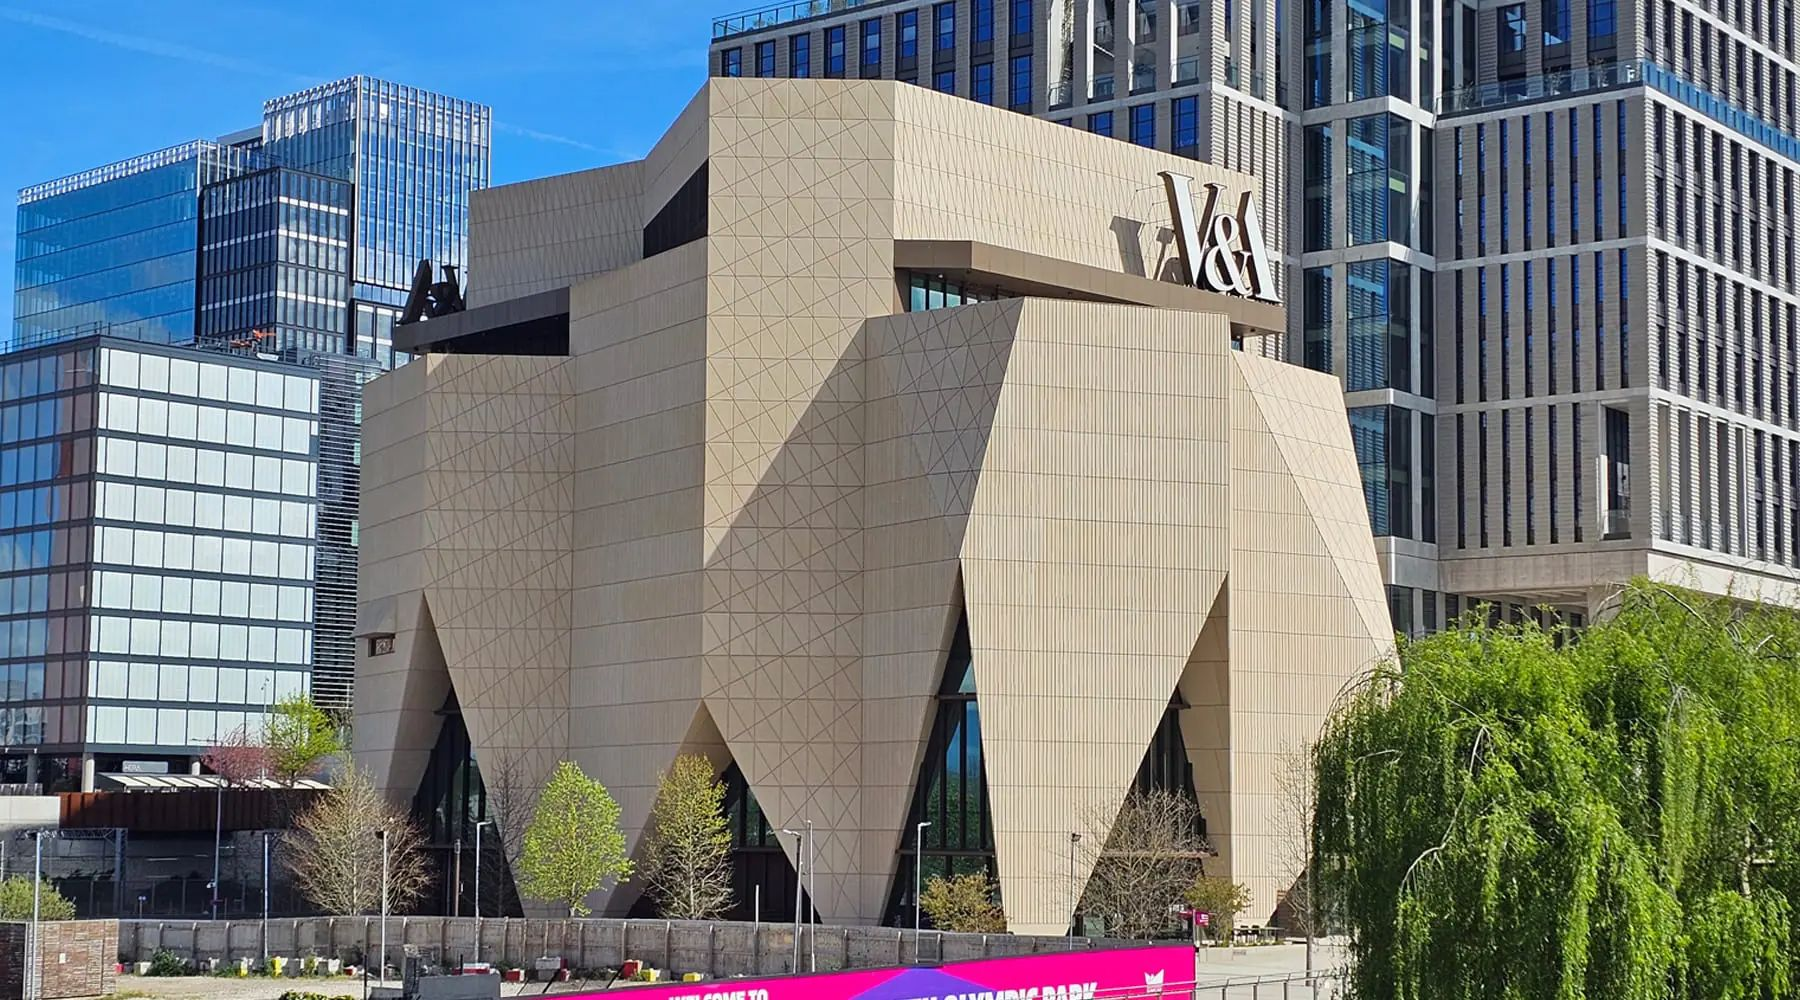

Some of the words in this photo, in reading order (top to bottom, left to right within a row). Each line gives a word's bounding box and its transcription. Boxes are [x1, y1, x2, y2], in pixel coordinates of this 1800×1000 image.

[1157, 171, 1282, 303] V&A
[668, 990, 746, 1000] COME
[944, 987, 1039, 1000] MPIC
